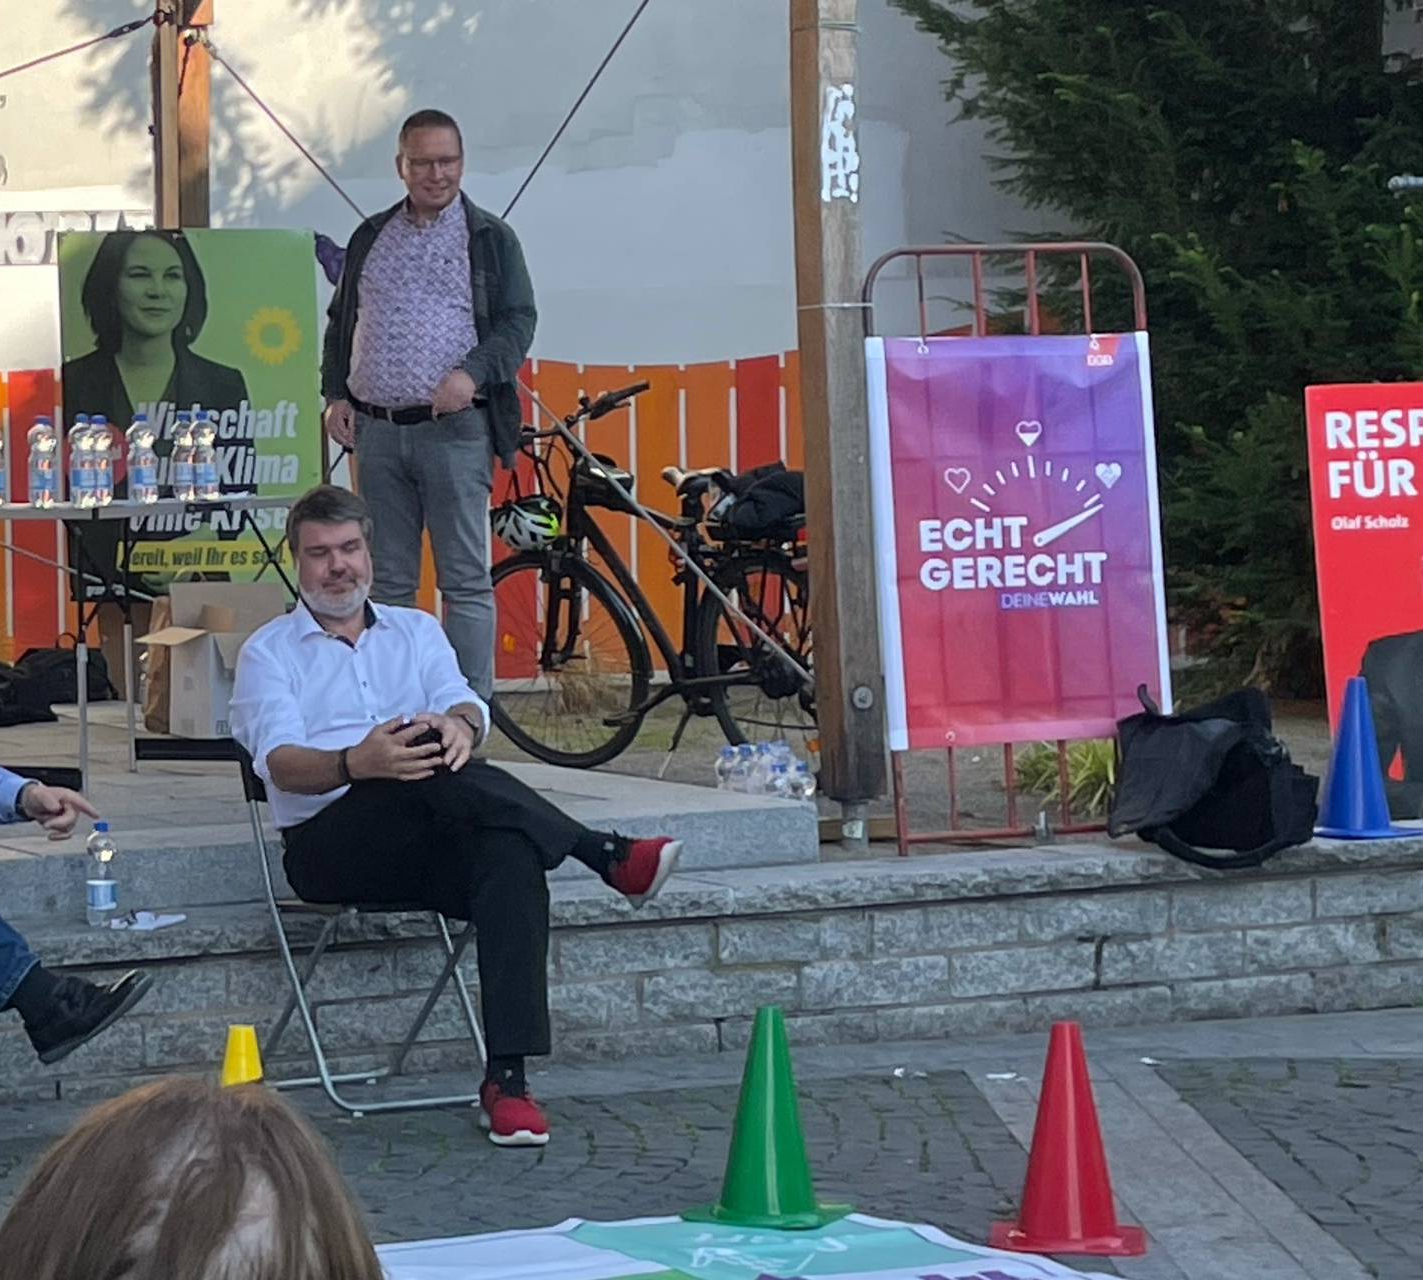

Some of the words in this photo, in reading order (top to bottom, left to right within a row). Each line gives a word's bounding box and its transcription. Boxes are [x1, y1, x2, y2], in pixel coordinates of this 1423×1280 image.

[137, 399, 299, 442] Wischaft
[1328, 450, 1419, 499] FÜR
[919, 516, 1028, 552] ECHT
[1331, 515, 1362, 531] Olaf
[1364, 514, 1409, 530] Scholz
[130, 547, 169, 568] ereit,
[919, 551, 1108, 591] GERECHT
[1000, 590, 1100, 610] DEINEWAHL
